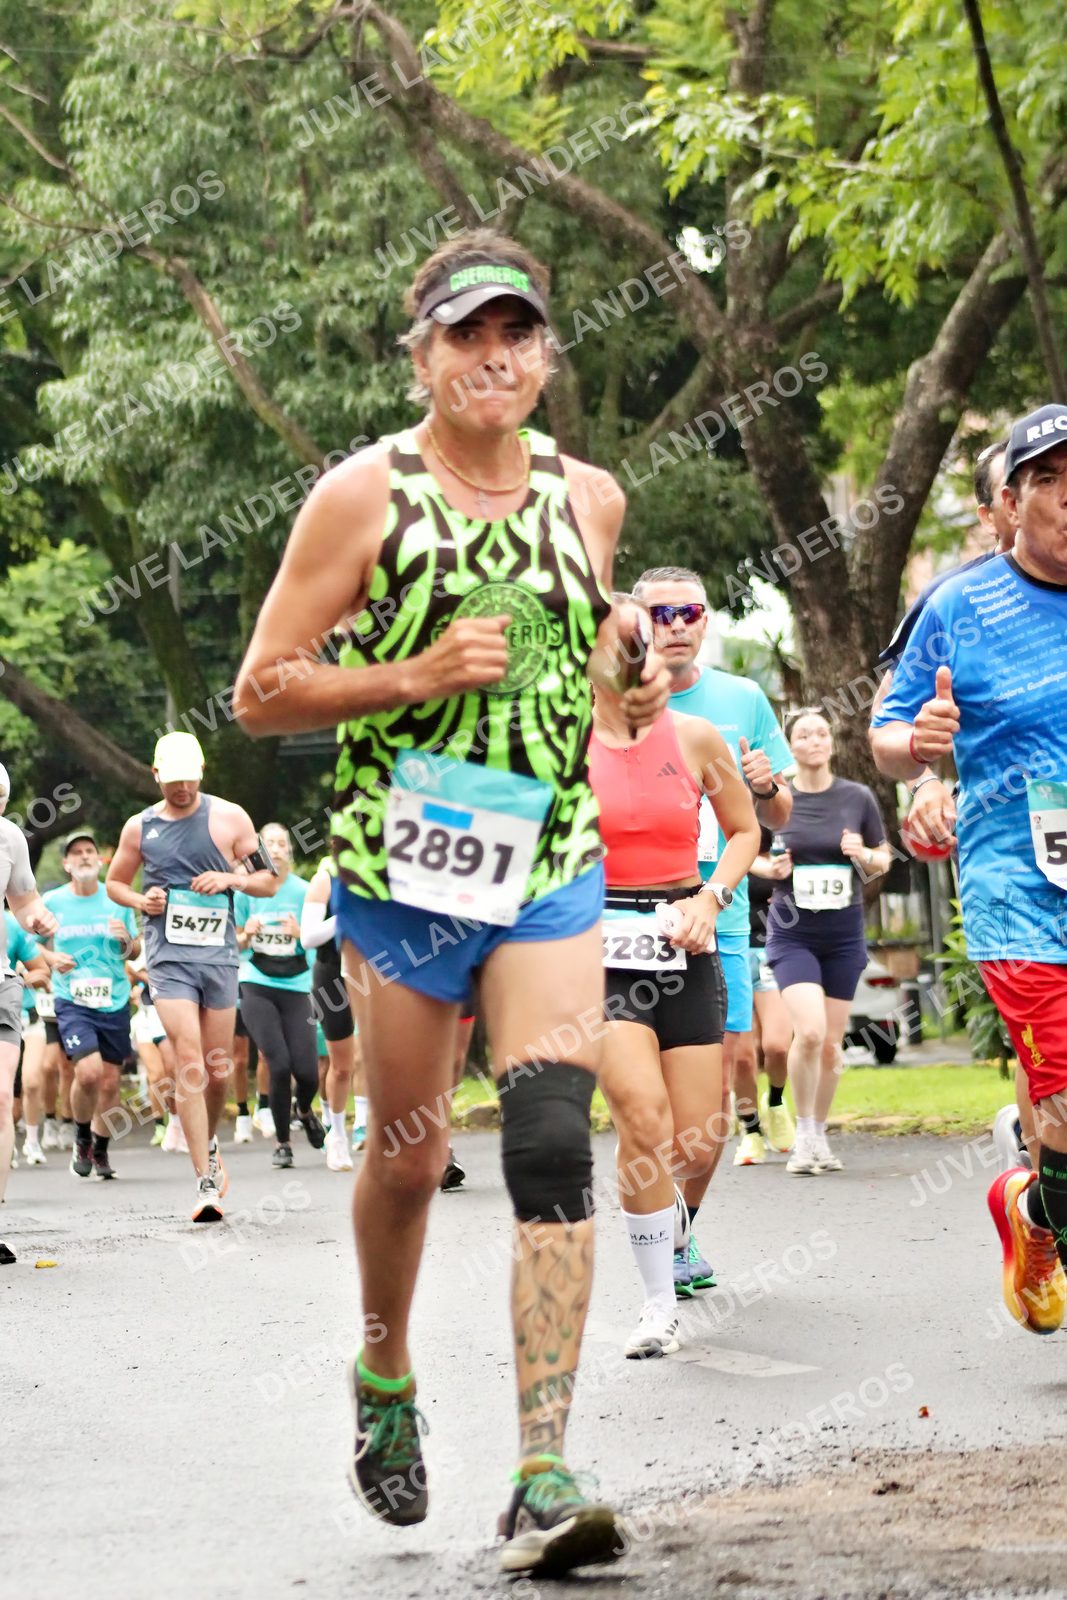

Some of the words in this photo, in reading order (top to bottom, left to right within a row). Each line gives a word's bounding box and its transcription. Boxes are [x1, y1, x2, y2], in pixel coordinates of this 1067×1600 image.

[389, 819, 514, 885] 2891
[171, 915, 222, 933] 5477
[630, 1230, 667, 1241] HALF
